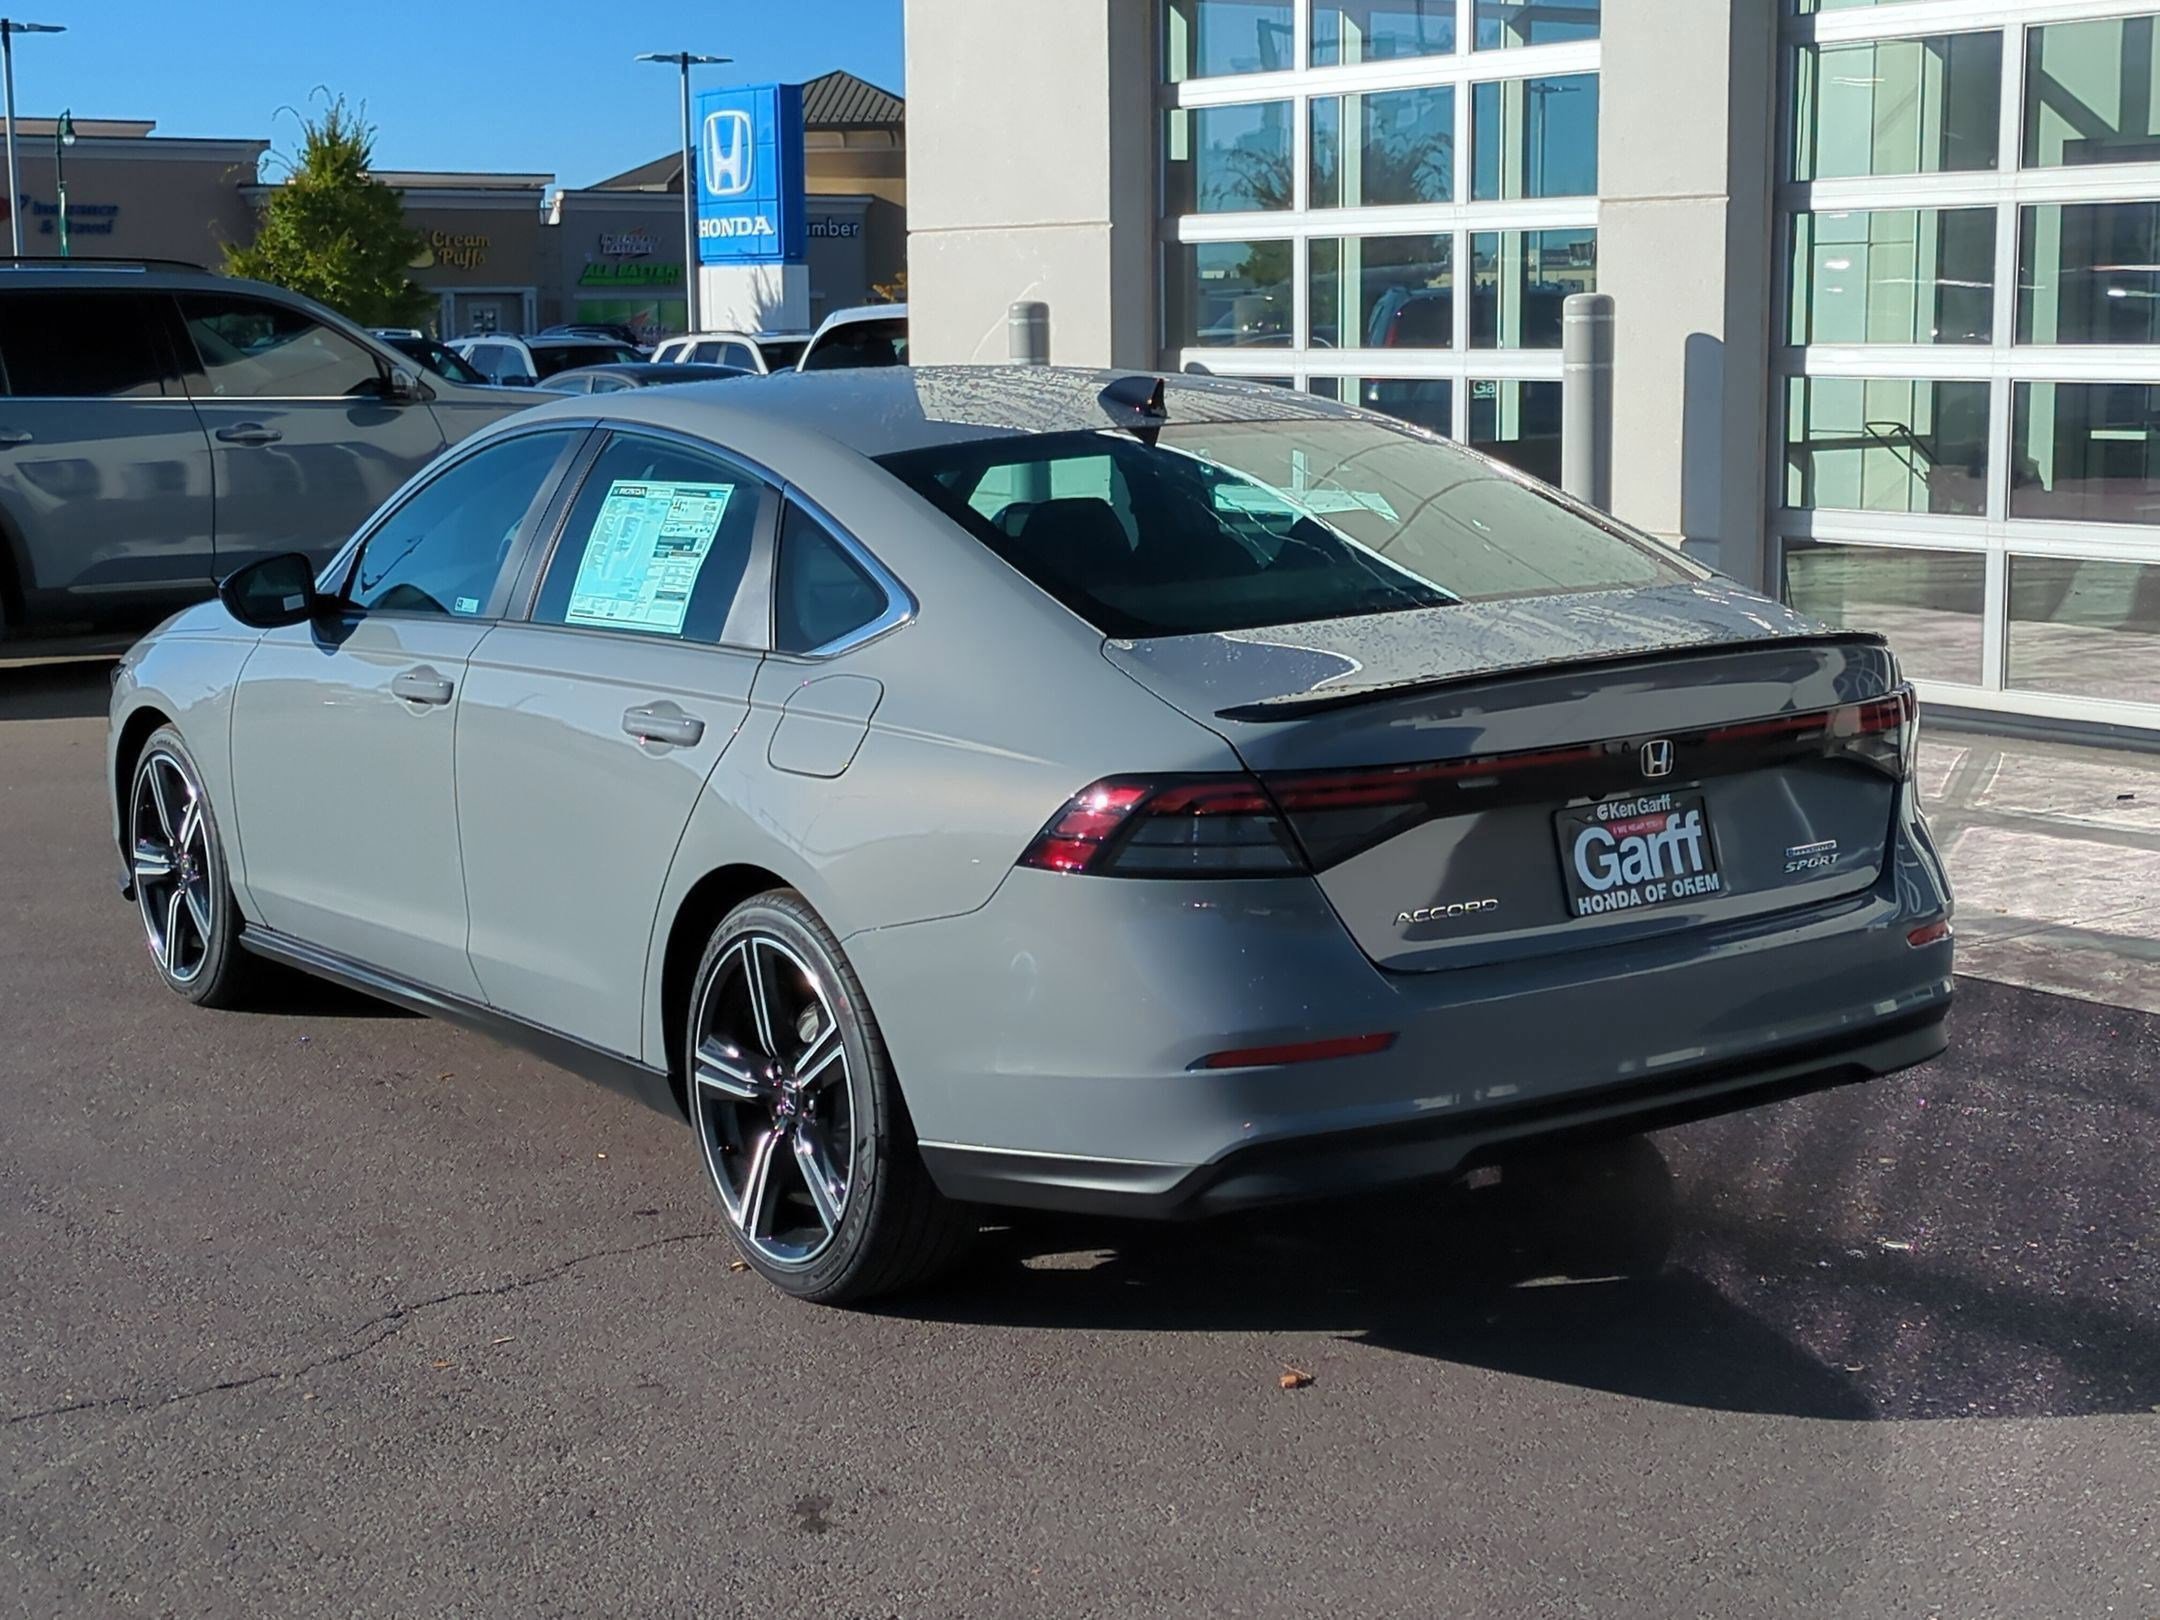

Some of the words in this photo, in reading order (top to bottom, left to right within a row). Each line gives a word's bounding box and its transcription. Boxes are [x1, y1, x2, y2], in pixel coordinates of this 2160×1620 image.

[431, 230, 491, 247] Cream
[698, 215, 775, 238] HONDA
[438, 247, 486, 270] Puffs
[1609, 801, 1637, 820] Ken
[1637, 794, 1671, 814] Garff
[1574, 810, 1703, 891] Garff
[1784, 852, 1840, 874] SPORT
[1577, 888, 1642, 916] HONDA
[1645, 883, 1667, 901] OF
[1393, 899, 1499, 926] ACCORD
